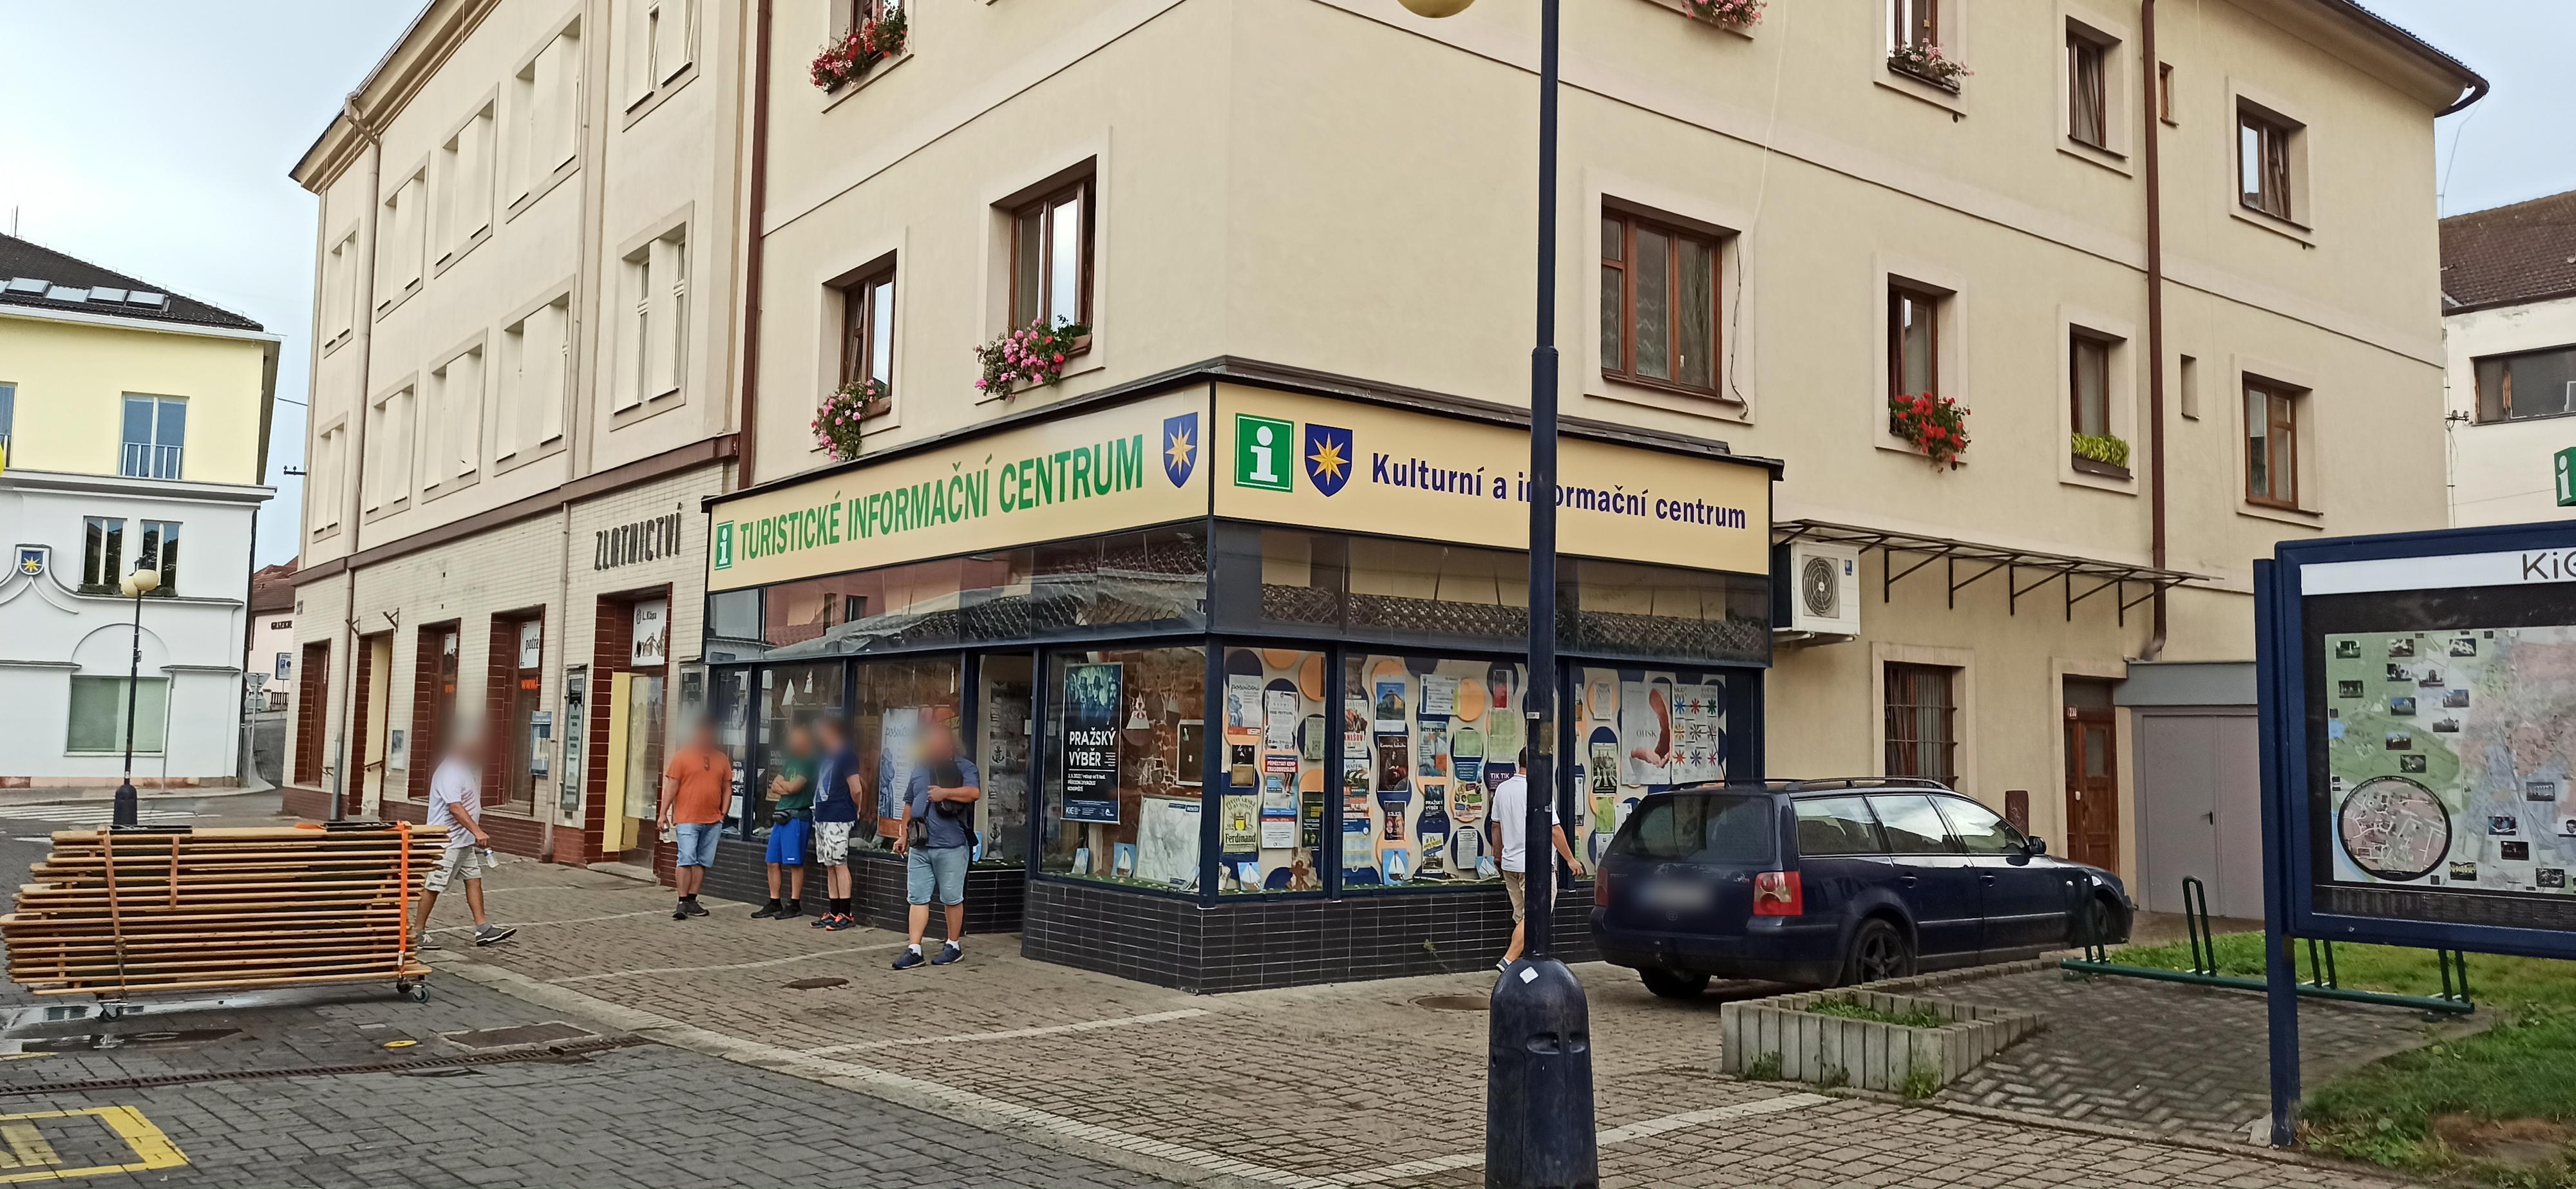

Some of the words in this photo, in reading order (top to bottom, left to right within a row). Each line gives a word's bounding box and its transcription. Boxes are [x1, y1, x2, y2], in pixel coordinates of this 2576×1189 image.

[741, 491, 841, 560] TURISTICKÉ
[848, 454, 992, 541] INFORMAČNÍ
[999, 434, 1143, 513] CENTRUM
[1372, 453, 1484, 496] Kulturní
[1493, 477, 1506, 500] a
[1518, 471, 1648, 516] iormační
[1656, 498, 1745, 529] centrum
[594, 502, 683, 571] ZLATNICTVÍ
[1069, 747, 1101, 766] VÝBĚR
[1070, 727, 1116, 745] PRAŽSKÝ
[1225, 832, 1256, 843] Ferdinand
